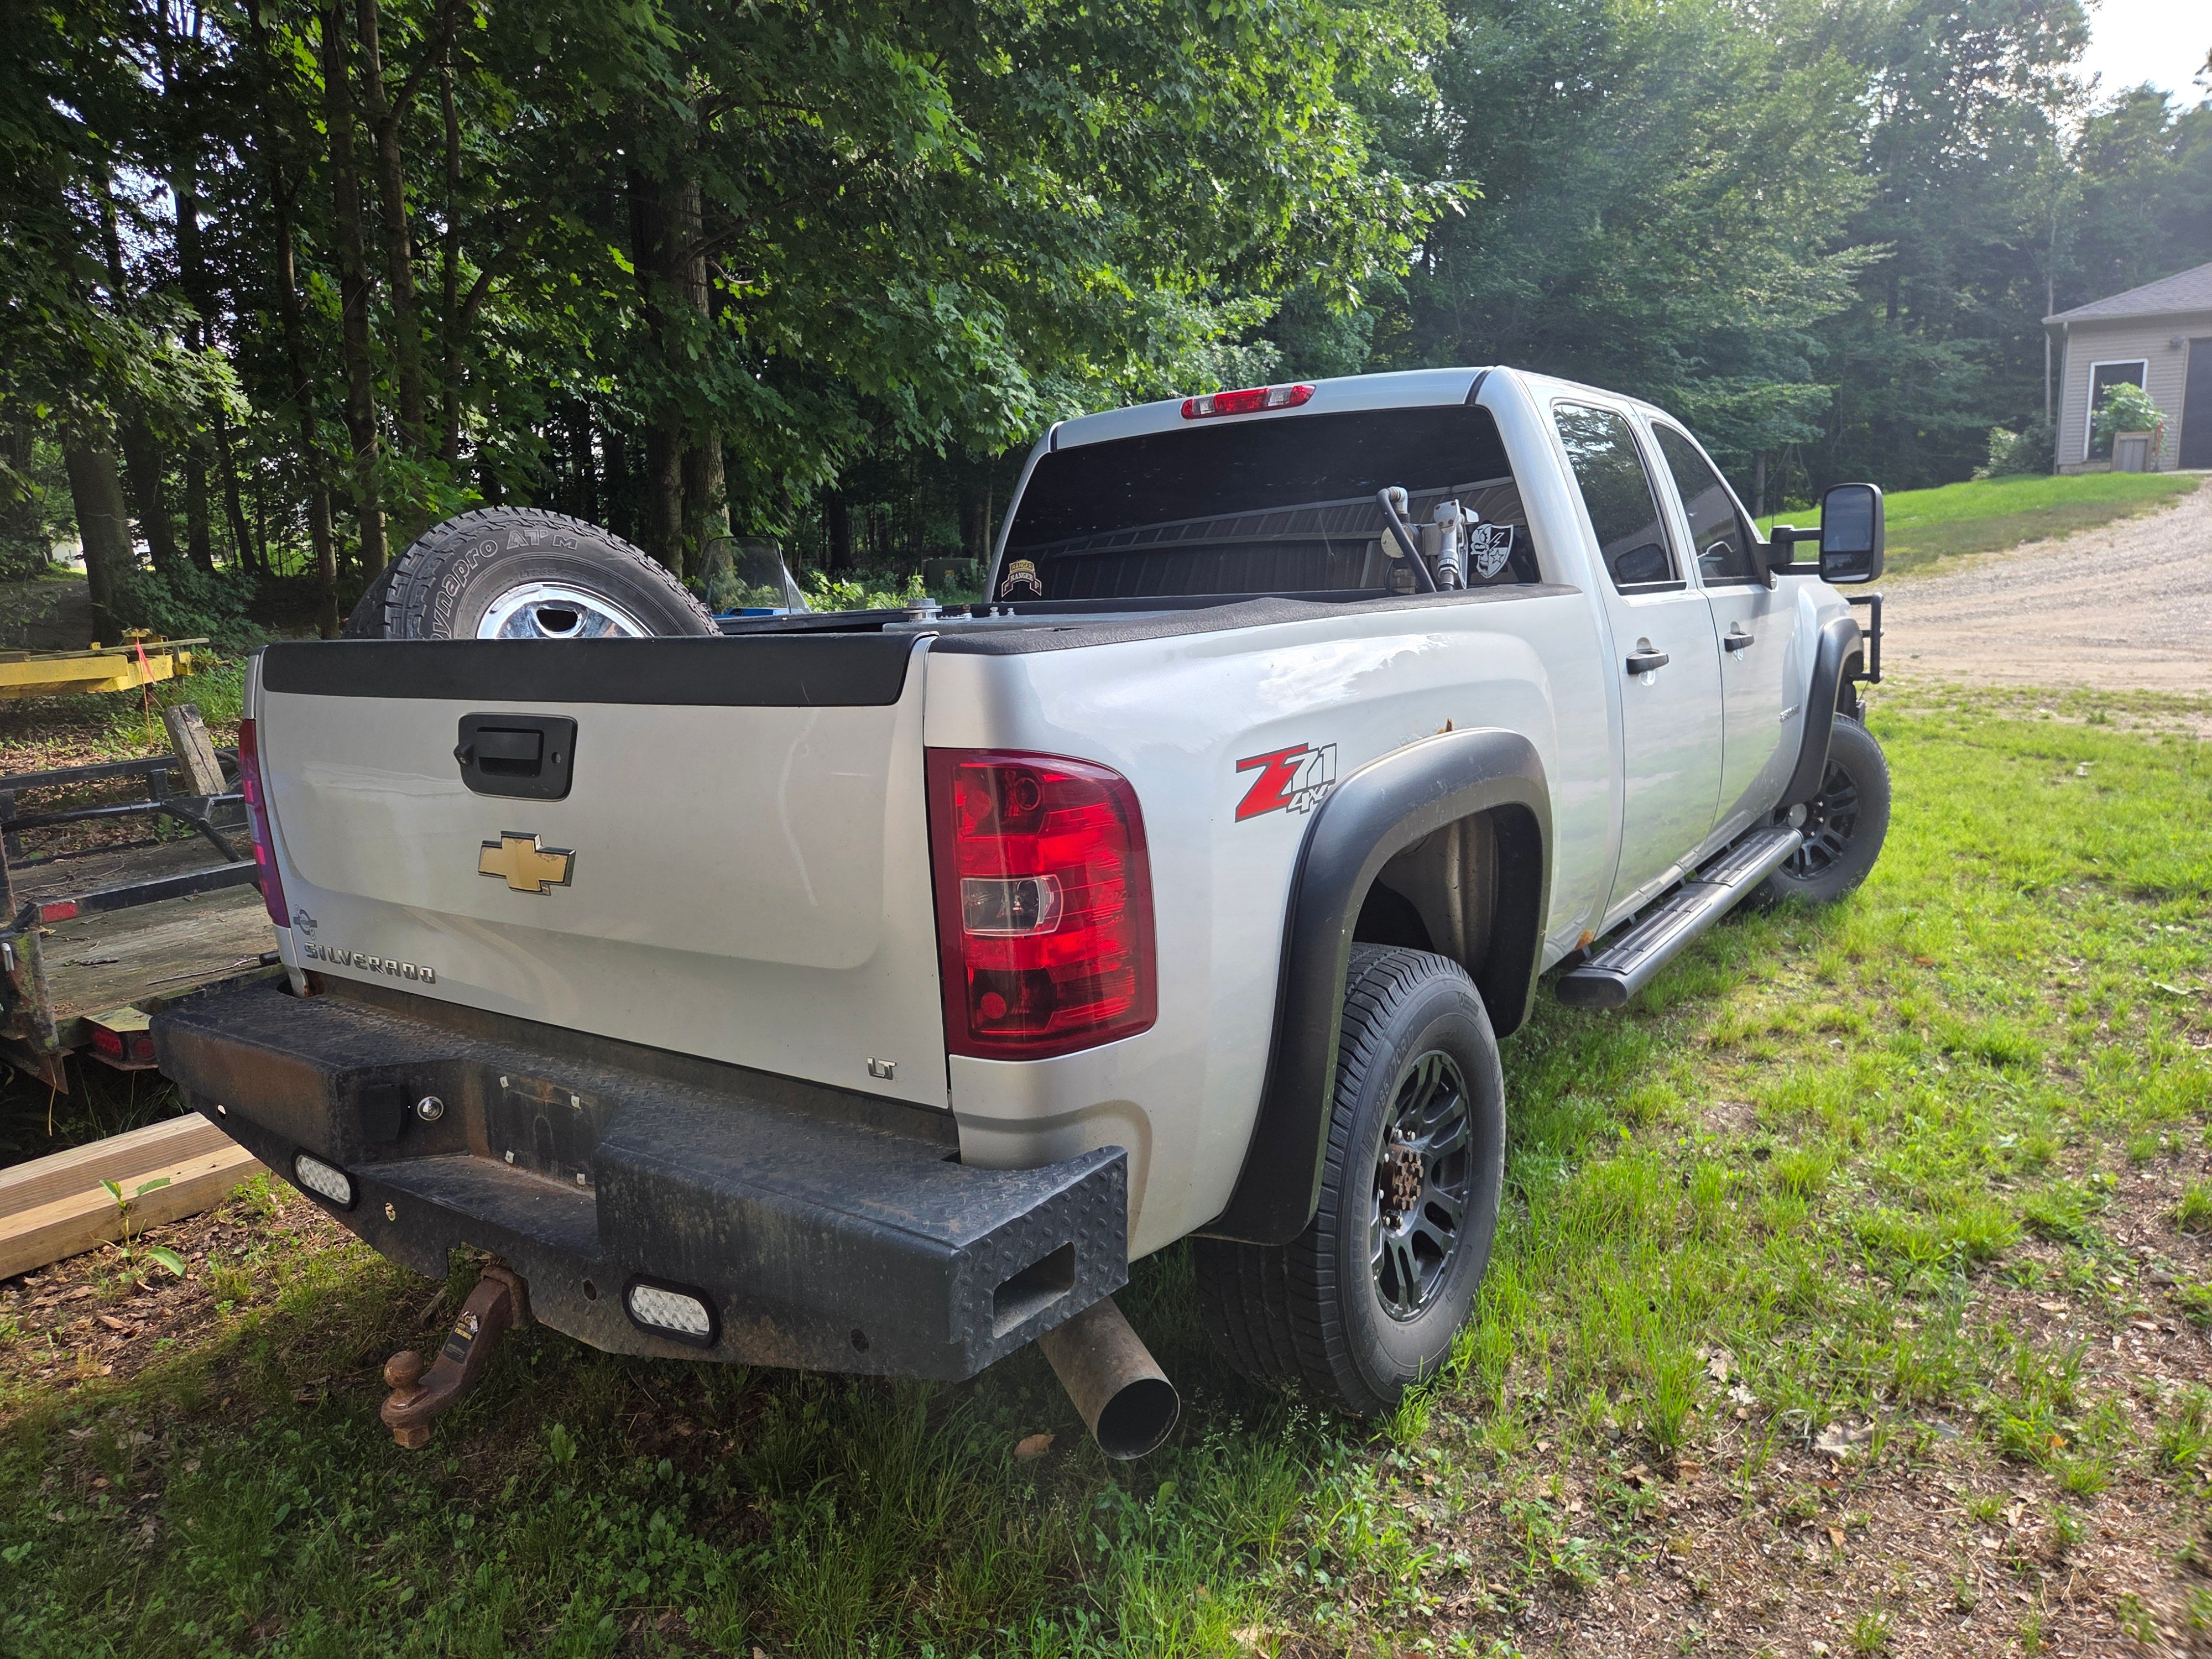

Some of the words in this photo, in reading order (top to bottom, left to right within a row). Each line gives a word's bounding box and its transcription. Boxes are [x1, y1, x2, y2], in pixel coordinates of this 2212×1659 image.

[1010, 572, 1034, 582] RANGER
[1011, 562, 1032, 570] RANGER
[430, 540, 498, 639] ynapro
[1235, 742, 1337, 823] Z71
[304, 942, 436, 984] SILVERADO
[867, 1057, 897, 1081] LT
